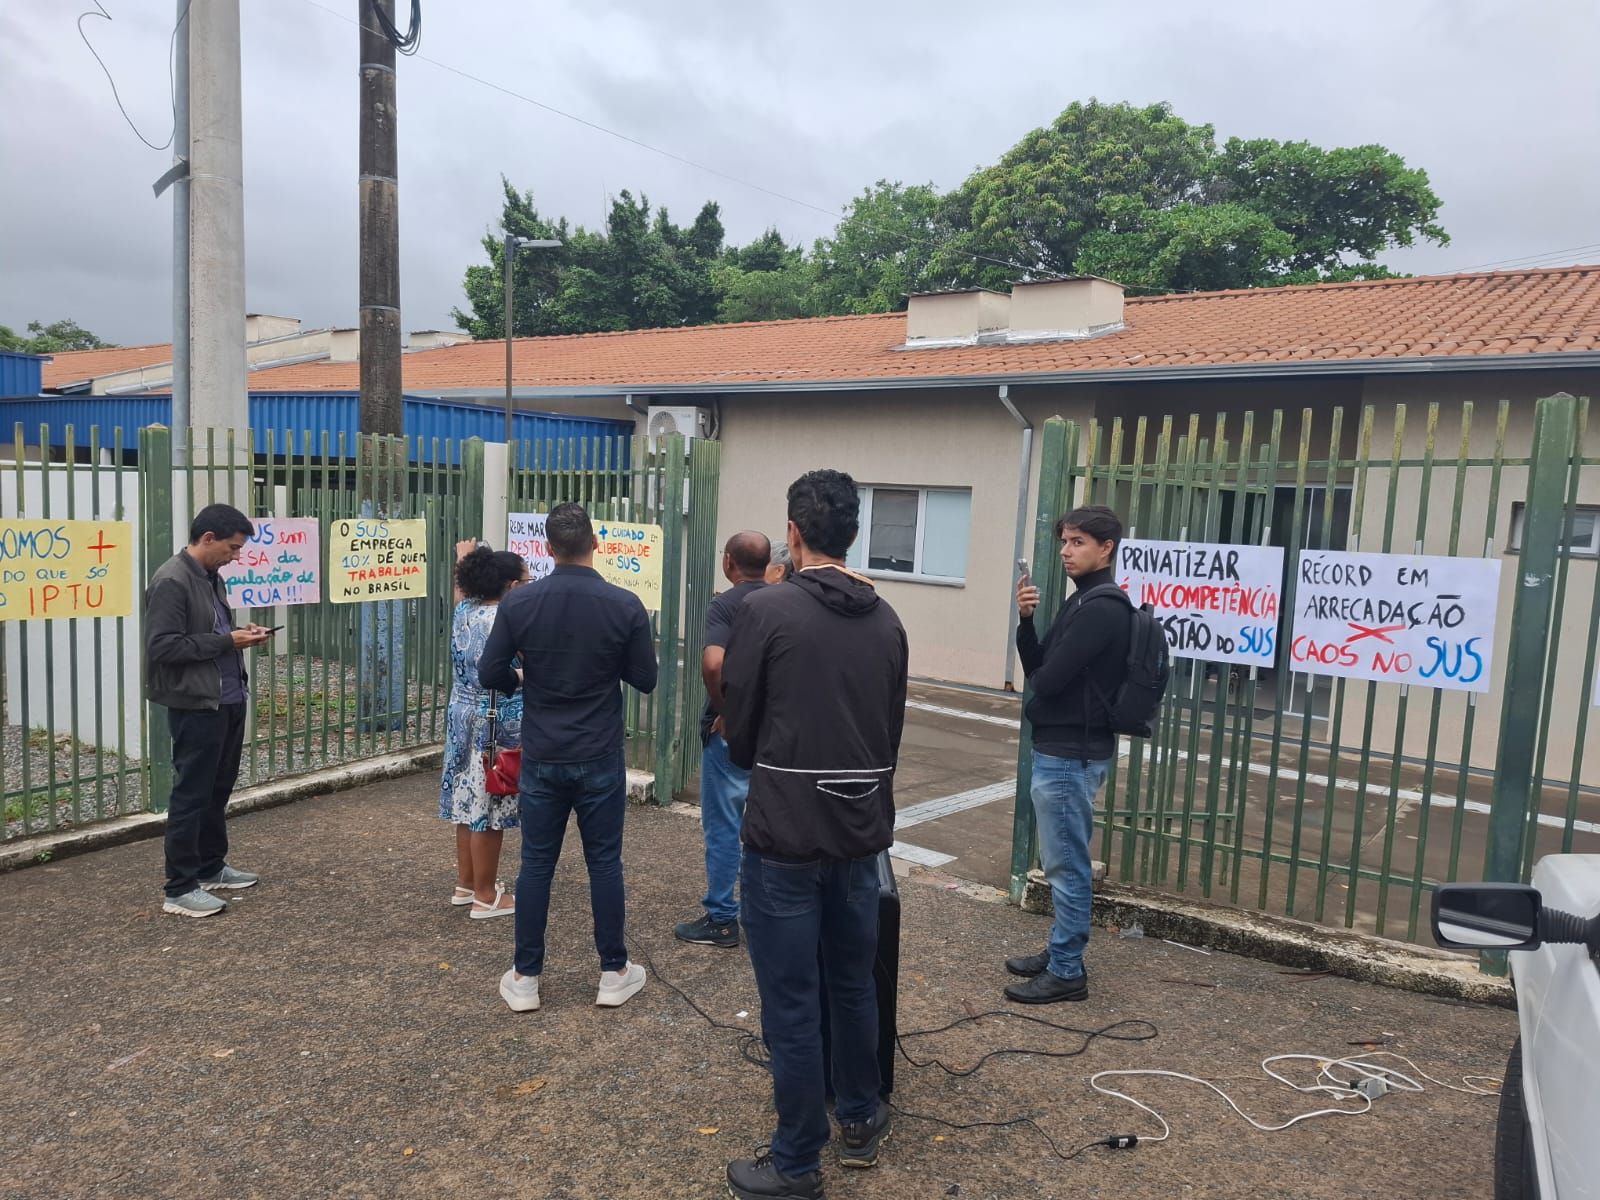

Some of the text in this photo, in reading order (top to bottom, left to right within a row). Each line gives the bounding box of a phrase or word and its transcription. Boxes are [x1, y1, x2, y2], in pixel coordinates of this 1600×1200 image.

[246, 523, 275, 545] US
[340, 520, 389, 538] O SUS
[509, 519, 546, 539] REDE MAR
[611, 527, 645, 541] CUIDADO
[0, 526, 71, 559] OMOS
[350, 538, 413, 552] EMPREGA
[511, 540, 550, 558] DESTRU
[597, 541, 651, 558] LIBERDADE
[237, 550, 302, 567] ESA da
[341, 551, 427, 569] 10% DE QUEM
[616, 555, 641, 573] SUS
[1121, 545, 1240, 581] PRIVATIZAR
[3, 570, 26, 583] DO
[36, 568, 69, 581] QUE
[225, 566, 315, 595] pulação de
[347, 566, 420, 582] TRABALHA
[1397, 567, 1428, 587] EM
[343, 578, 411, 597] NO BRASIL
[29, 583, 103, 616] IPTU
[1141, 576, 1277, 620] INCOMPETÊNCIA
[1303, 594, 1465, 629] ARRECADAÇÃO
[1153, 613, 1275, 656] STÃO DO SUS
[1291, 635, 1483, 683] CAOS NO SUS
